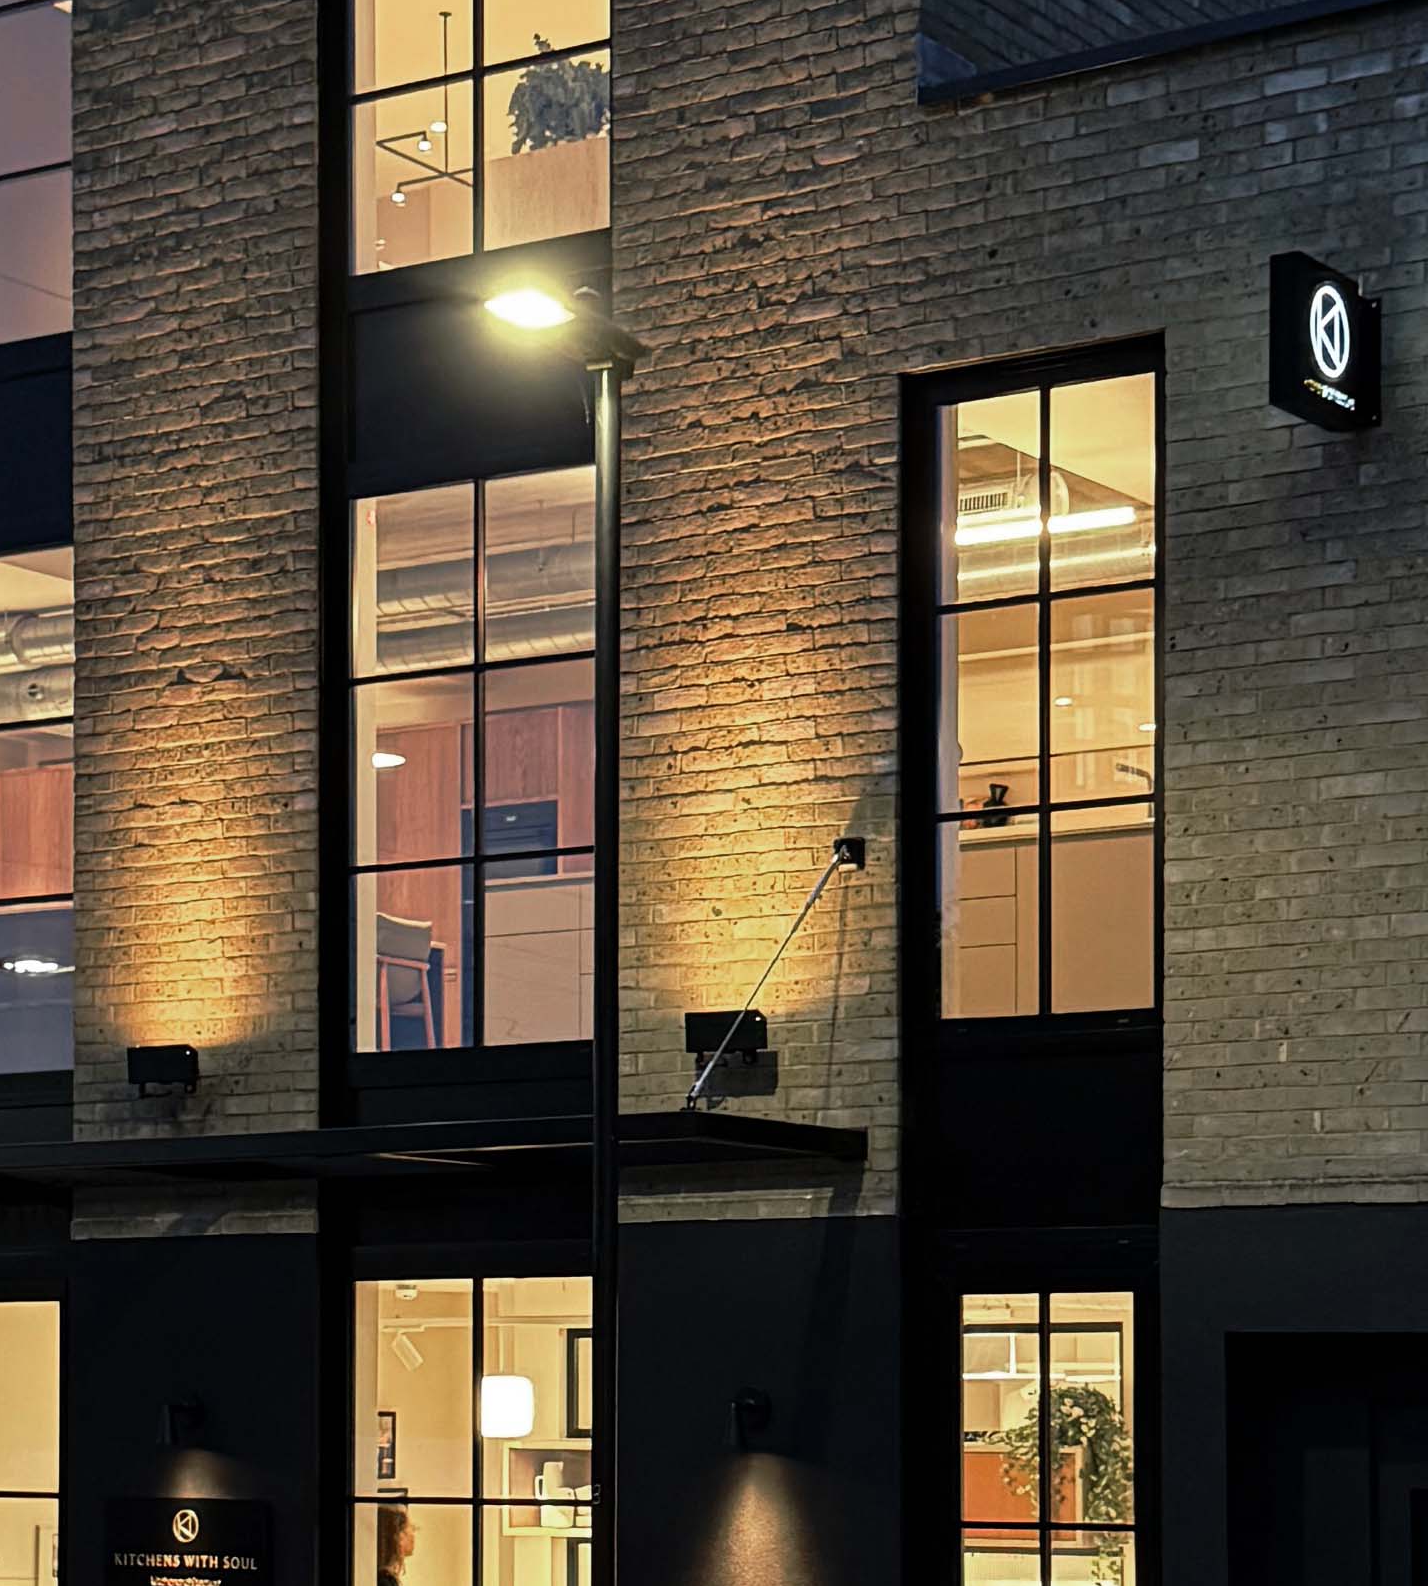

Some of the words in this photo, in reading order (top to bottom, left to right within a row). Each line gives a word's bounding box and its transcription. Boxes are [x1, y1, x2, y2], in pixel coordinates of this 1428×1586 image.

[114, 1553, 181, 1568] KITCHENS
[183, 1554, 219, 1569] WITH
[222, 1555, 258, 1570] SOUL
